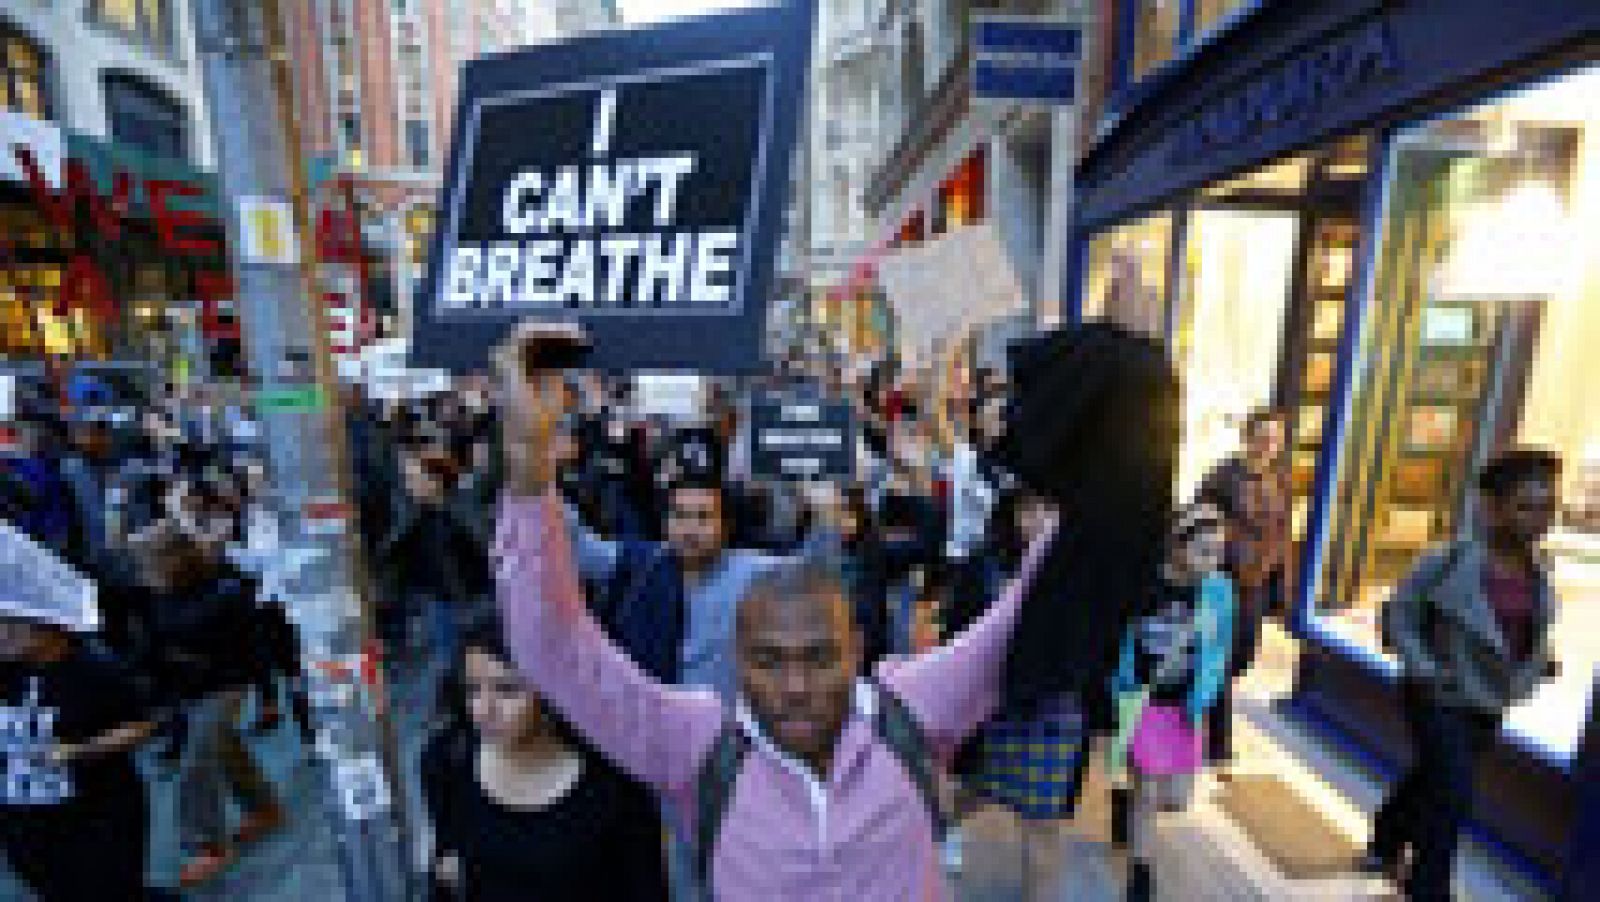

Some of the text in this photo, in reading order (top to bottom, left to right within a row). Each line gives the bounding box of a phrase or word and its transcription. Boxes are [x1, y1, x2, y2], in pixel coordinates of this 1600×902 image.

[593, 89, 617, 152] I
[502, 156, 692, 233] CAN'T
[443, 232, 738, 303] BREATHE
